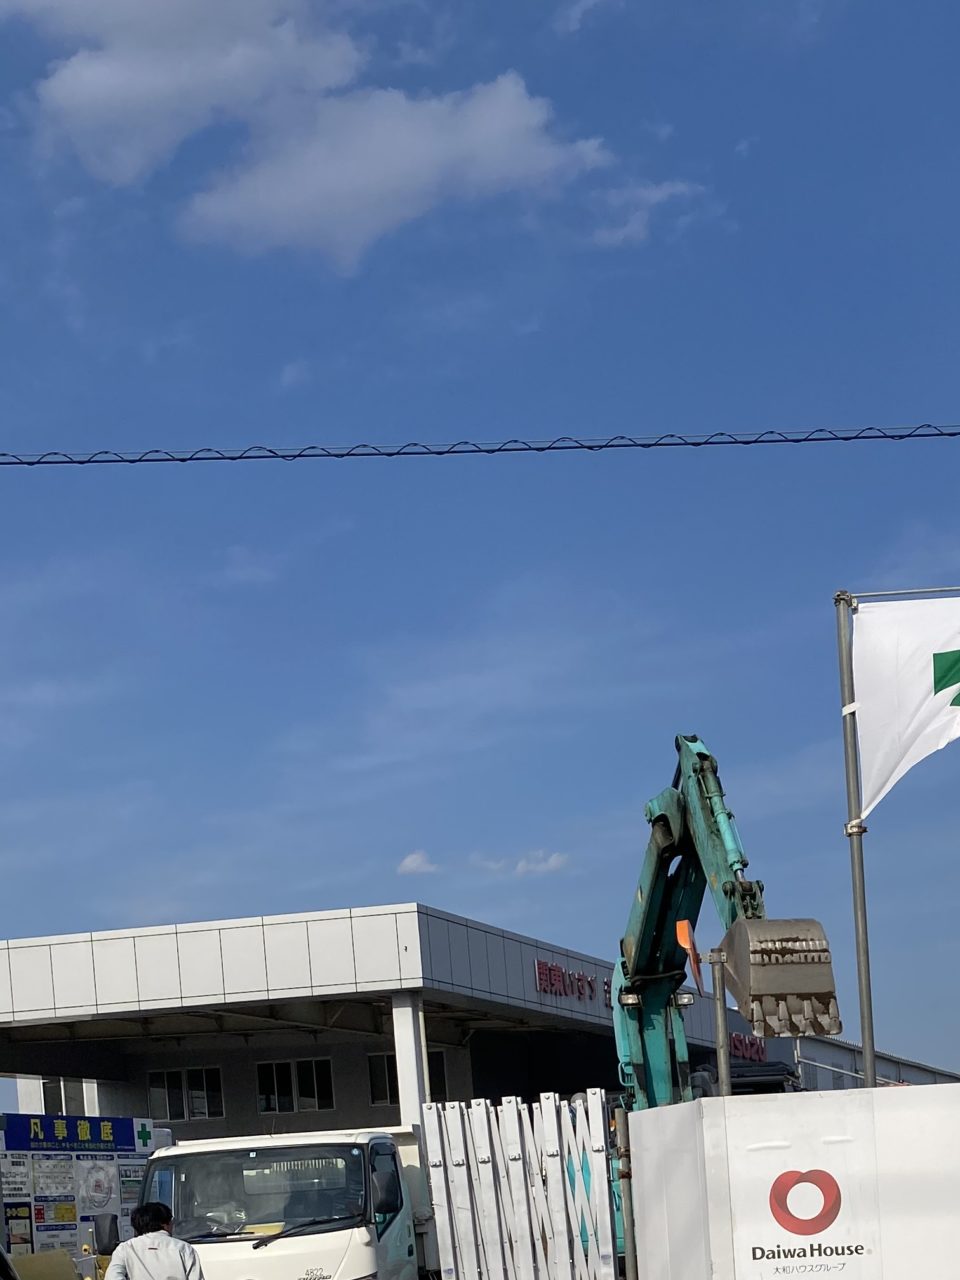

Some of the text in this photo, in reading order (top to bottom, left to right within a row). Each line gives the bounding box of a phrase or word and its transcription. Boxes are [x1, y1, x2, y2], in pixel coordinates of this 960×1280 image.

[751, 1243, 865, 1261] Daiwa House
[772, 1262, 847, 1275] 大和ハウスグループ
